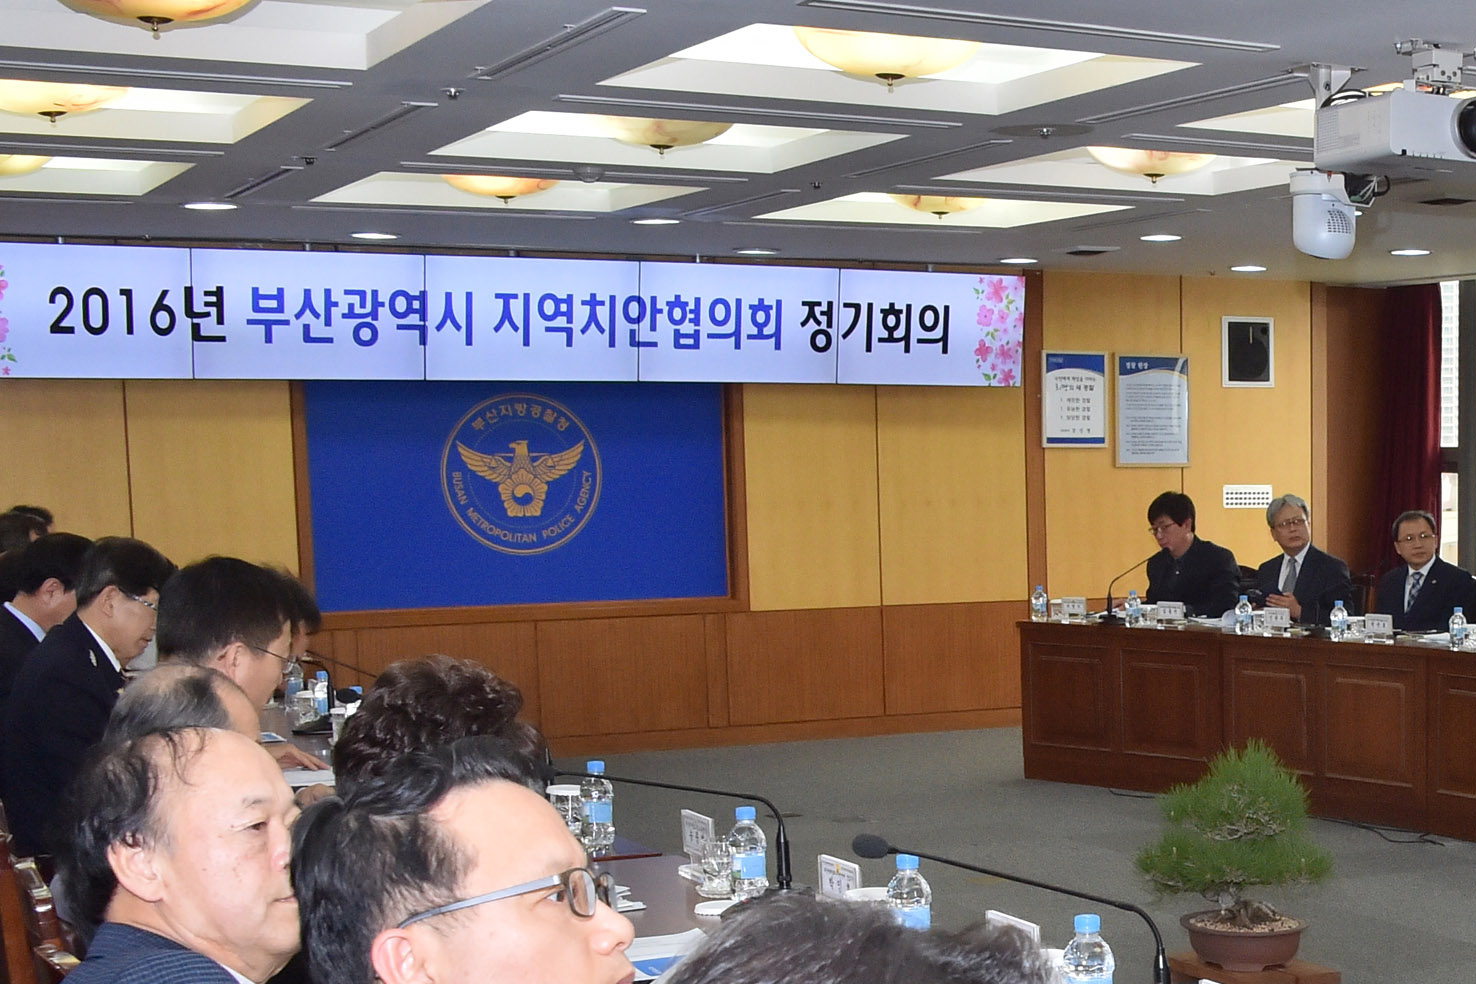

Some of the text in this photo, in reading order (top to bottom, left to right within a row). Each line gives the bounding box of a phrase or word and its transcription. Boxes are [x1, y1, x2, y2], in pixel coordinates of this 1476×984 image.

[47, 284, 952, 355] 2016년 부산광역시 지역치안협의회 정기회의
[472, 403, 571, 431] 부산지방경찰청
[452, 470, 592, 543] BUSAN METROPOLITAN POLICE AGENCY
